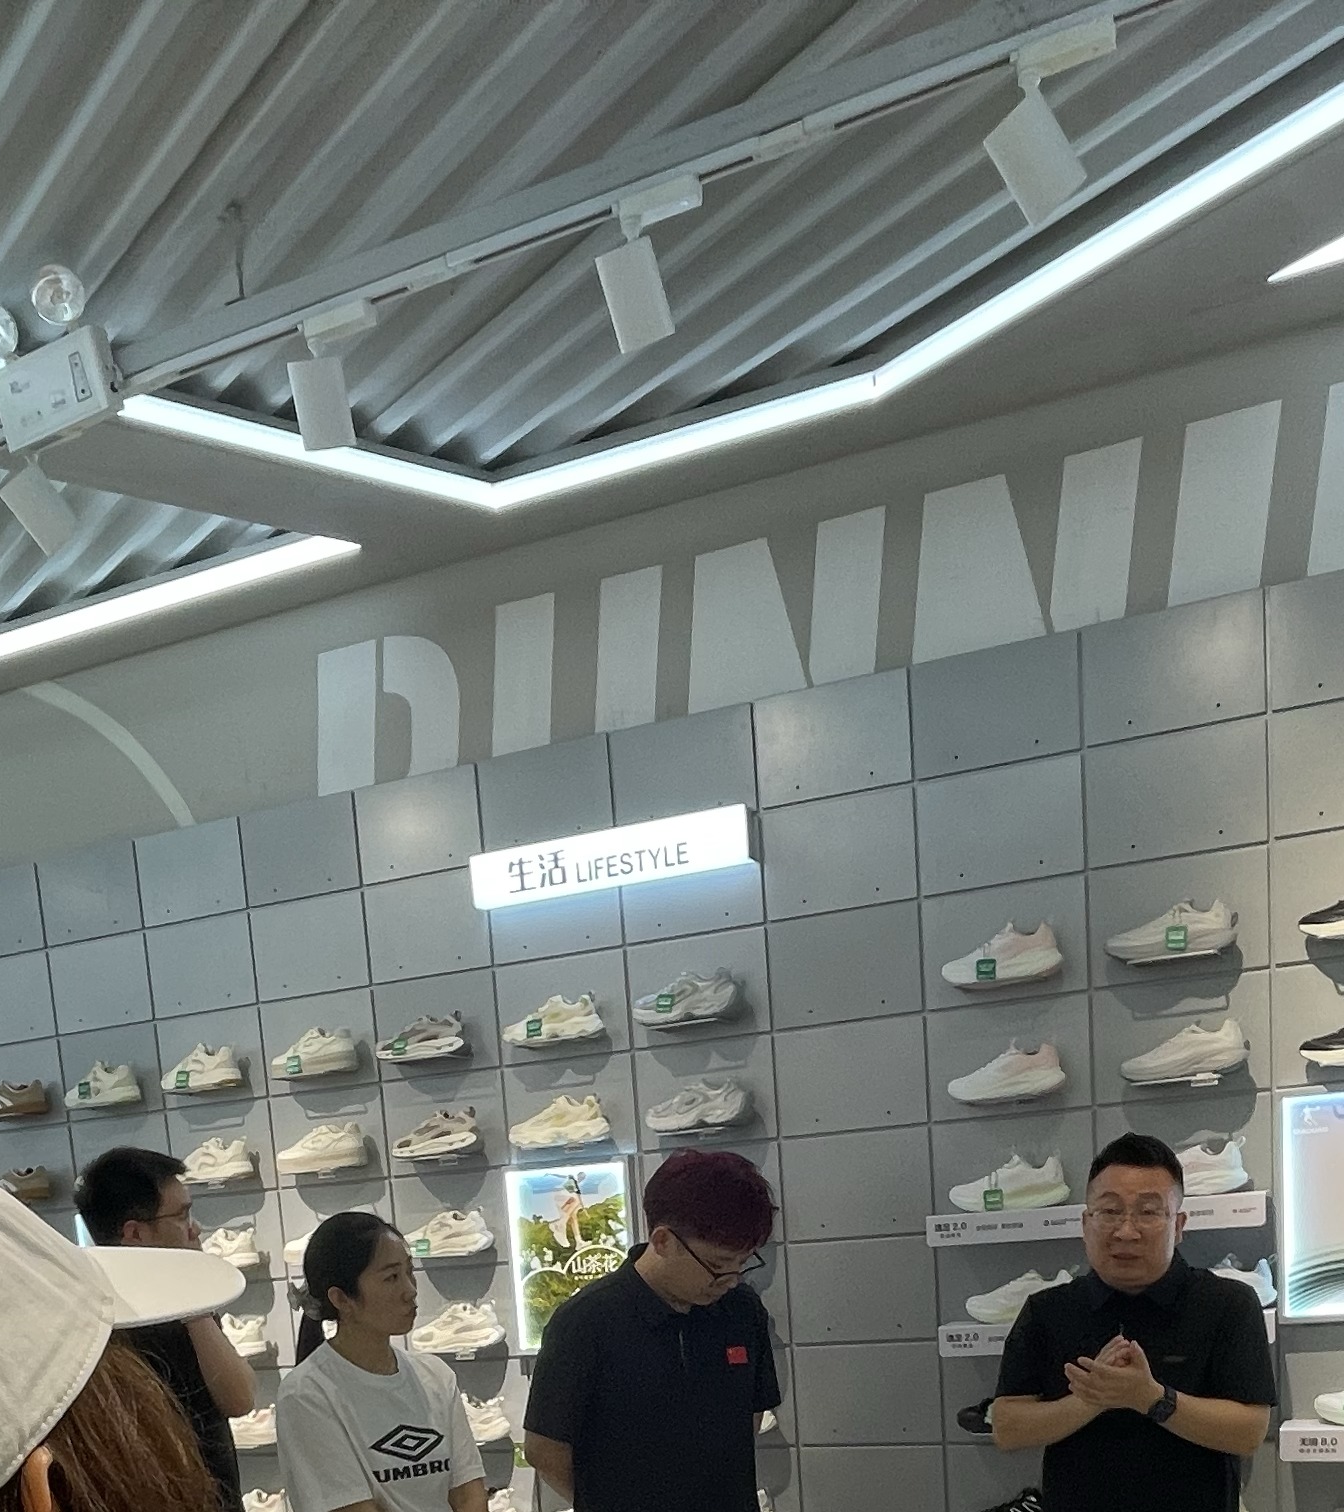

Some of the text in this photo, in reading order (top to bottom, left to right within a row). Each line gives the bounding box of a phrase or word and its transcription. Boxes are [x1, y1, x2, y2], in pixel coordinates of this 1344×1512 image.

[508, 842, 690, 893] 生活 LIFESTYLE
[571, 1252, 619, 1274] 山茶花
